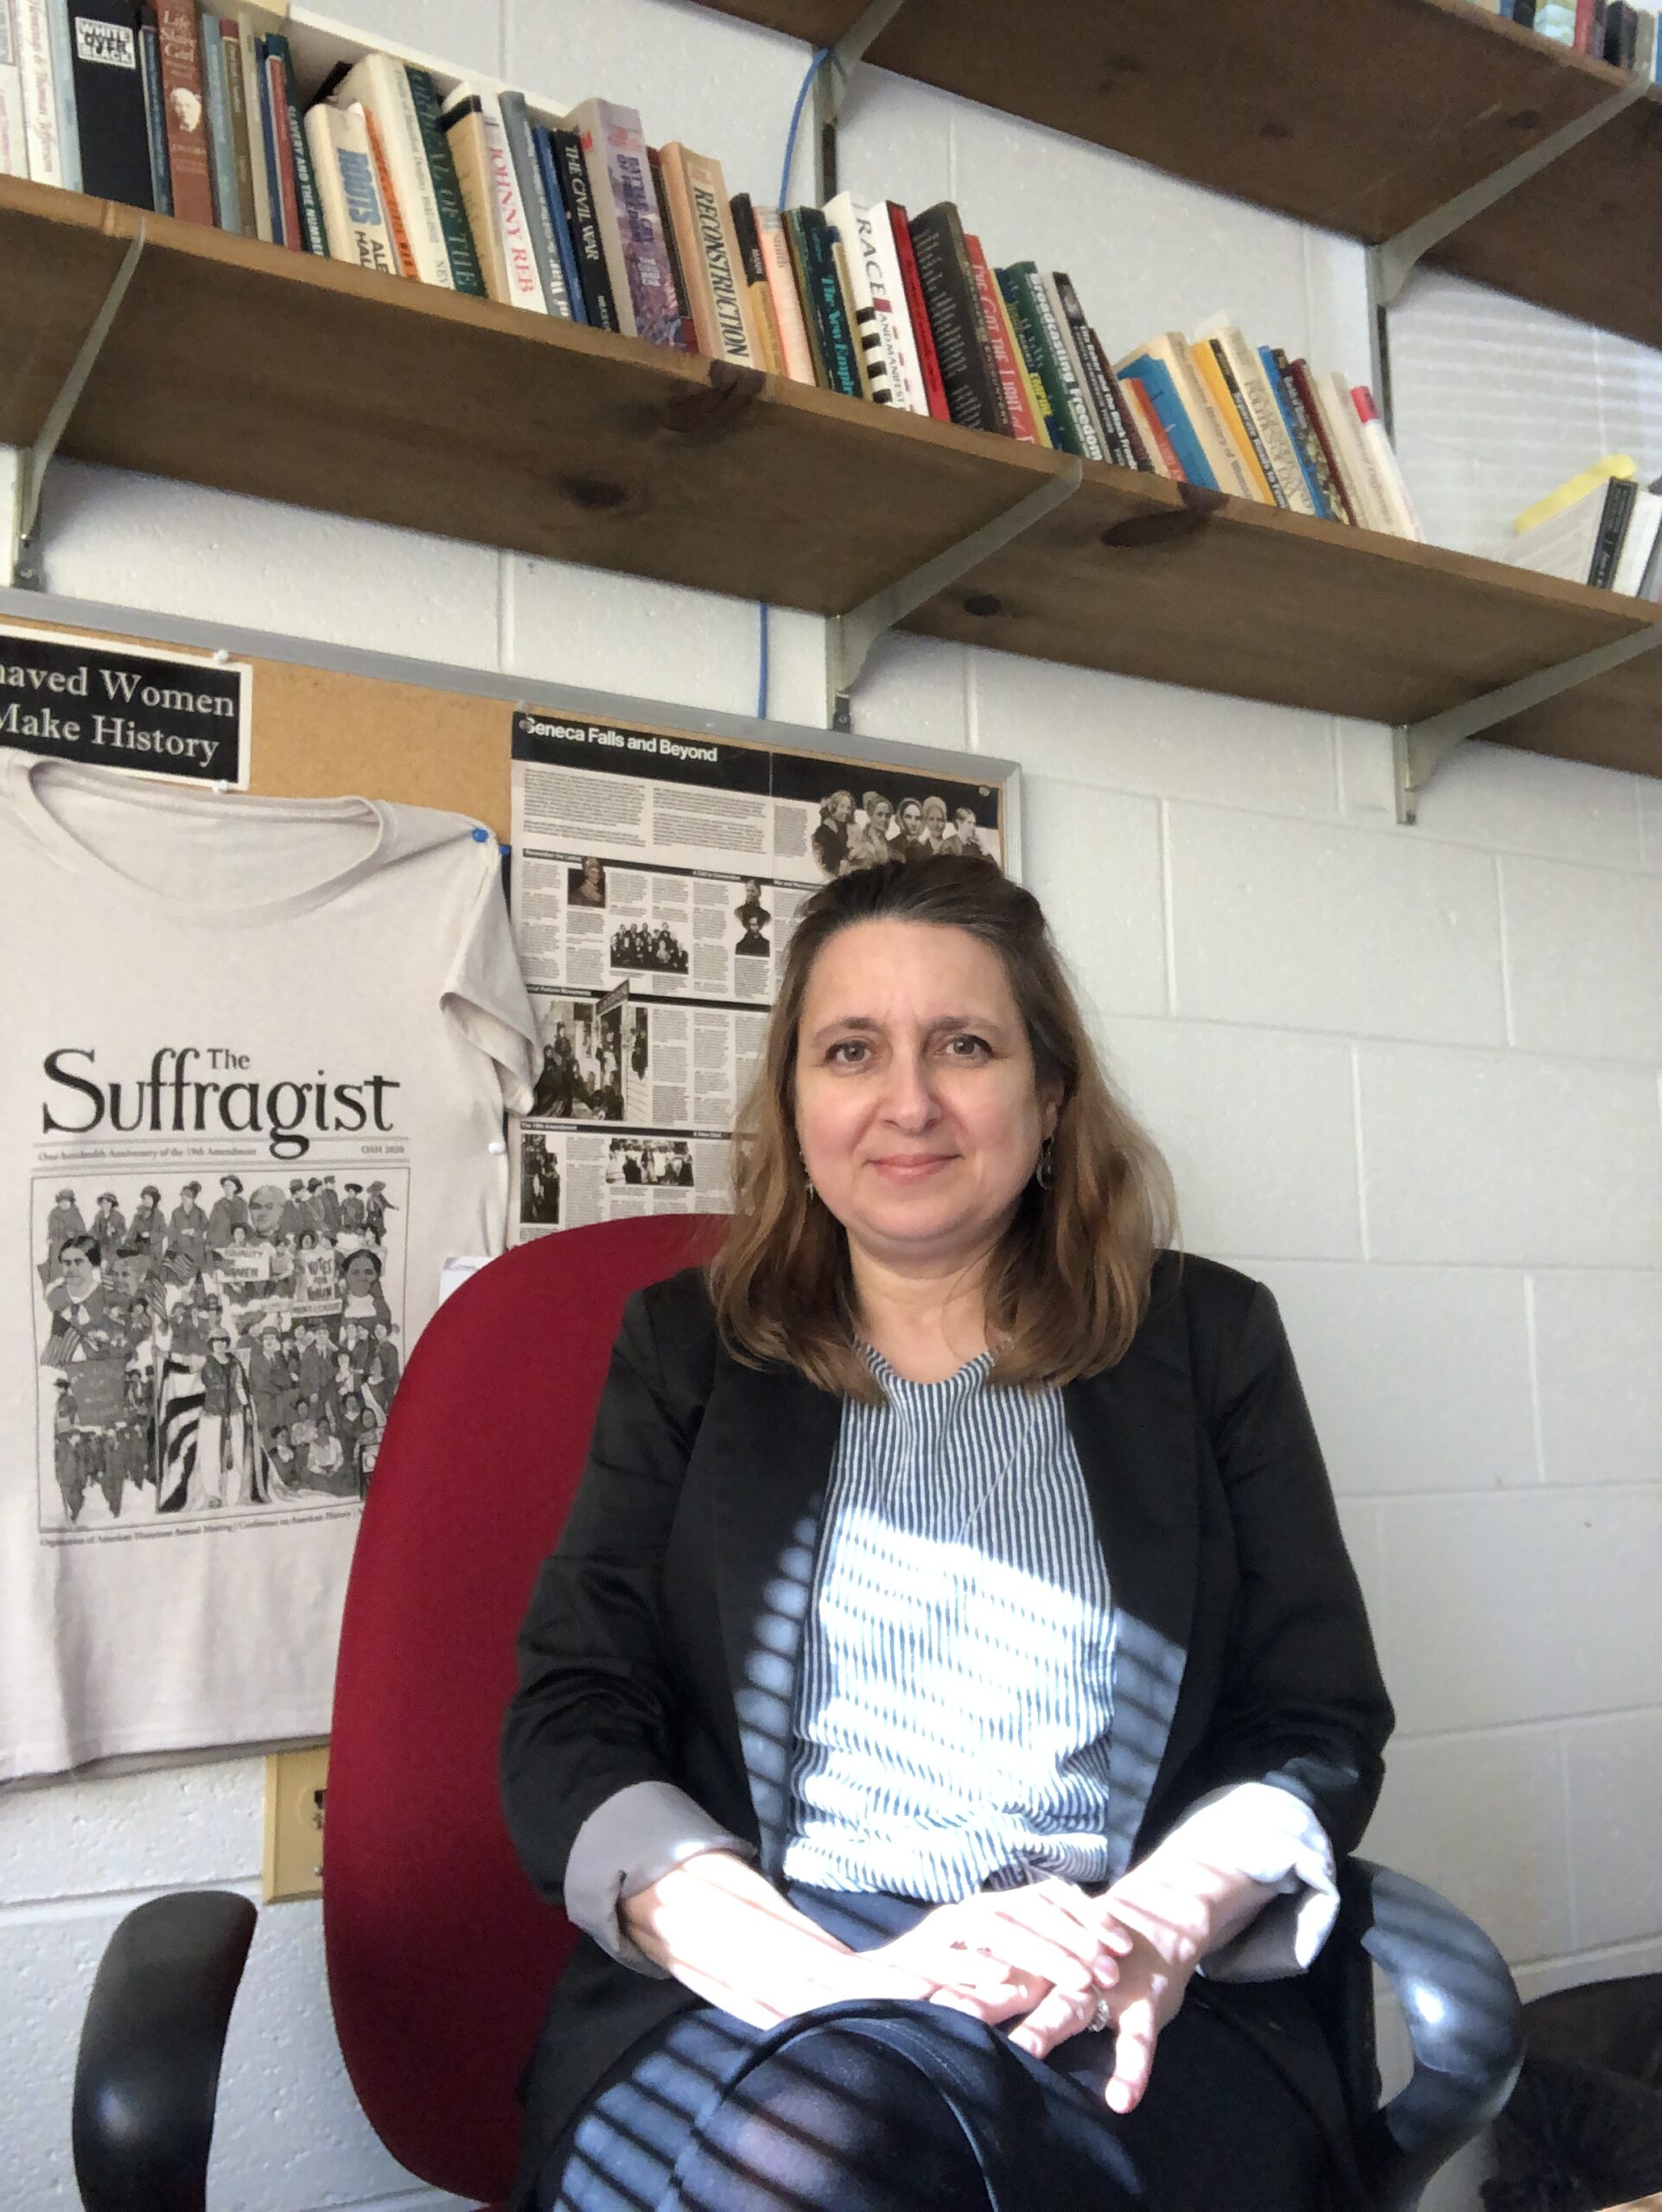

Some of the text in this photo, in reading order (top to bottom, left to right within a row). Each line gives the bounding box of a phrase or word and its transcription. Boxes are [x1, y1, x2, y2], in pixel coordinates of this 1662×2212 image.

[79, 21, 130, 42] WHITE
[85, 32, 128, 54] OVER
[81, 45, 131, 66] BLACK
[296, 158, 309, 182] AND
[301, 183, 314, 207] THE
[564, 143, 601, 261] THE CIVIL WAR
[489, 145, 534, 293] JOHNNY REB
[449, 232, 476, 288] THE
[693, 186, 749, 359] RECONSTRUCTION
[856, 217, 906, 403] RACE AND MANIFEST
[991, 339, 1010, 364] THE
[1028, 272, 1076, 383] Broadcasting
[1069, 387, 1104, 461] Freedom
[100, 671, 235, 718] Women
[0, 702, 220, 767] Make History
[589, 728, 624, 747] Falls
[627, 737, 657, 753] and
[659, 740, 718, 763] Beyond
[207, 1047, 251, 1071] The
[41, 1046, 402, 1160] Suffragist
[160, 1147, 172, 1158] of
[173, 1147, 183, 1157] the
[187, 1147, 204, 1157] 19th
[207, 1147, 258, 1157] Amendment
